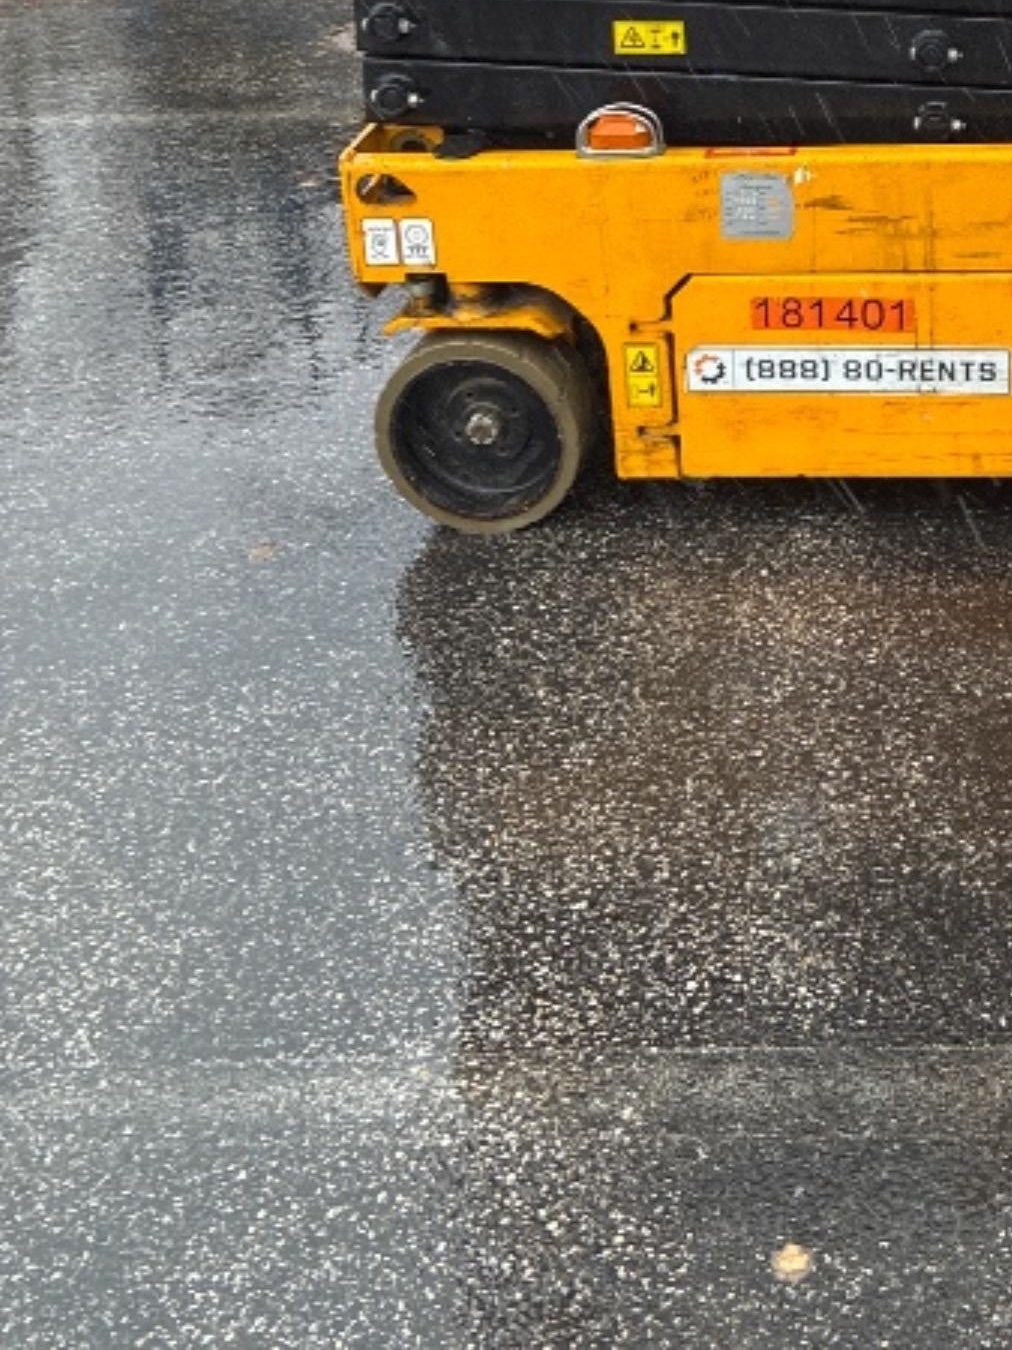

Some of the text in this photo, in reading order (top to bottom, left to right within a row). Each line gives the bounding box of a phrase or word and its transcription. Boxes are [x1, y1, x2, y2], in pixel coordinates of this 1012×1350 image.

[754, 297, 906, 330] 181401
[745, 358, 998, 382] (888) 80-RENTS
